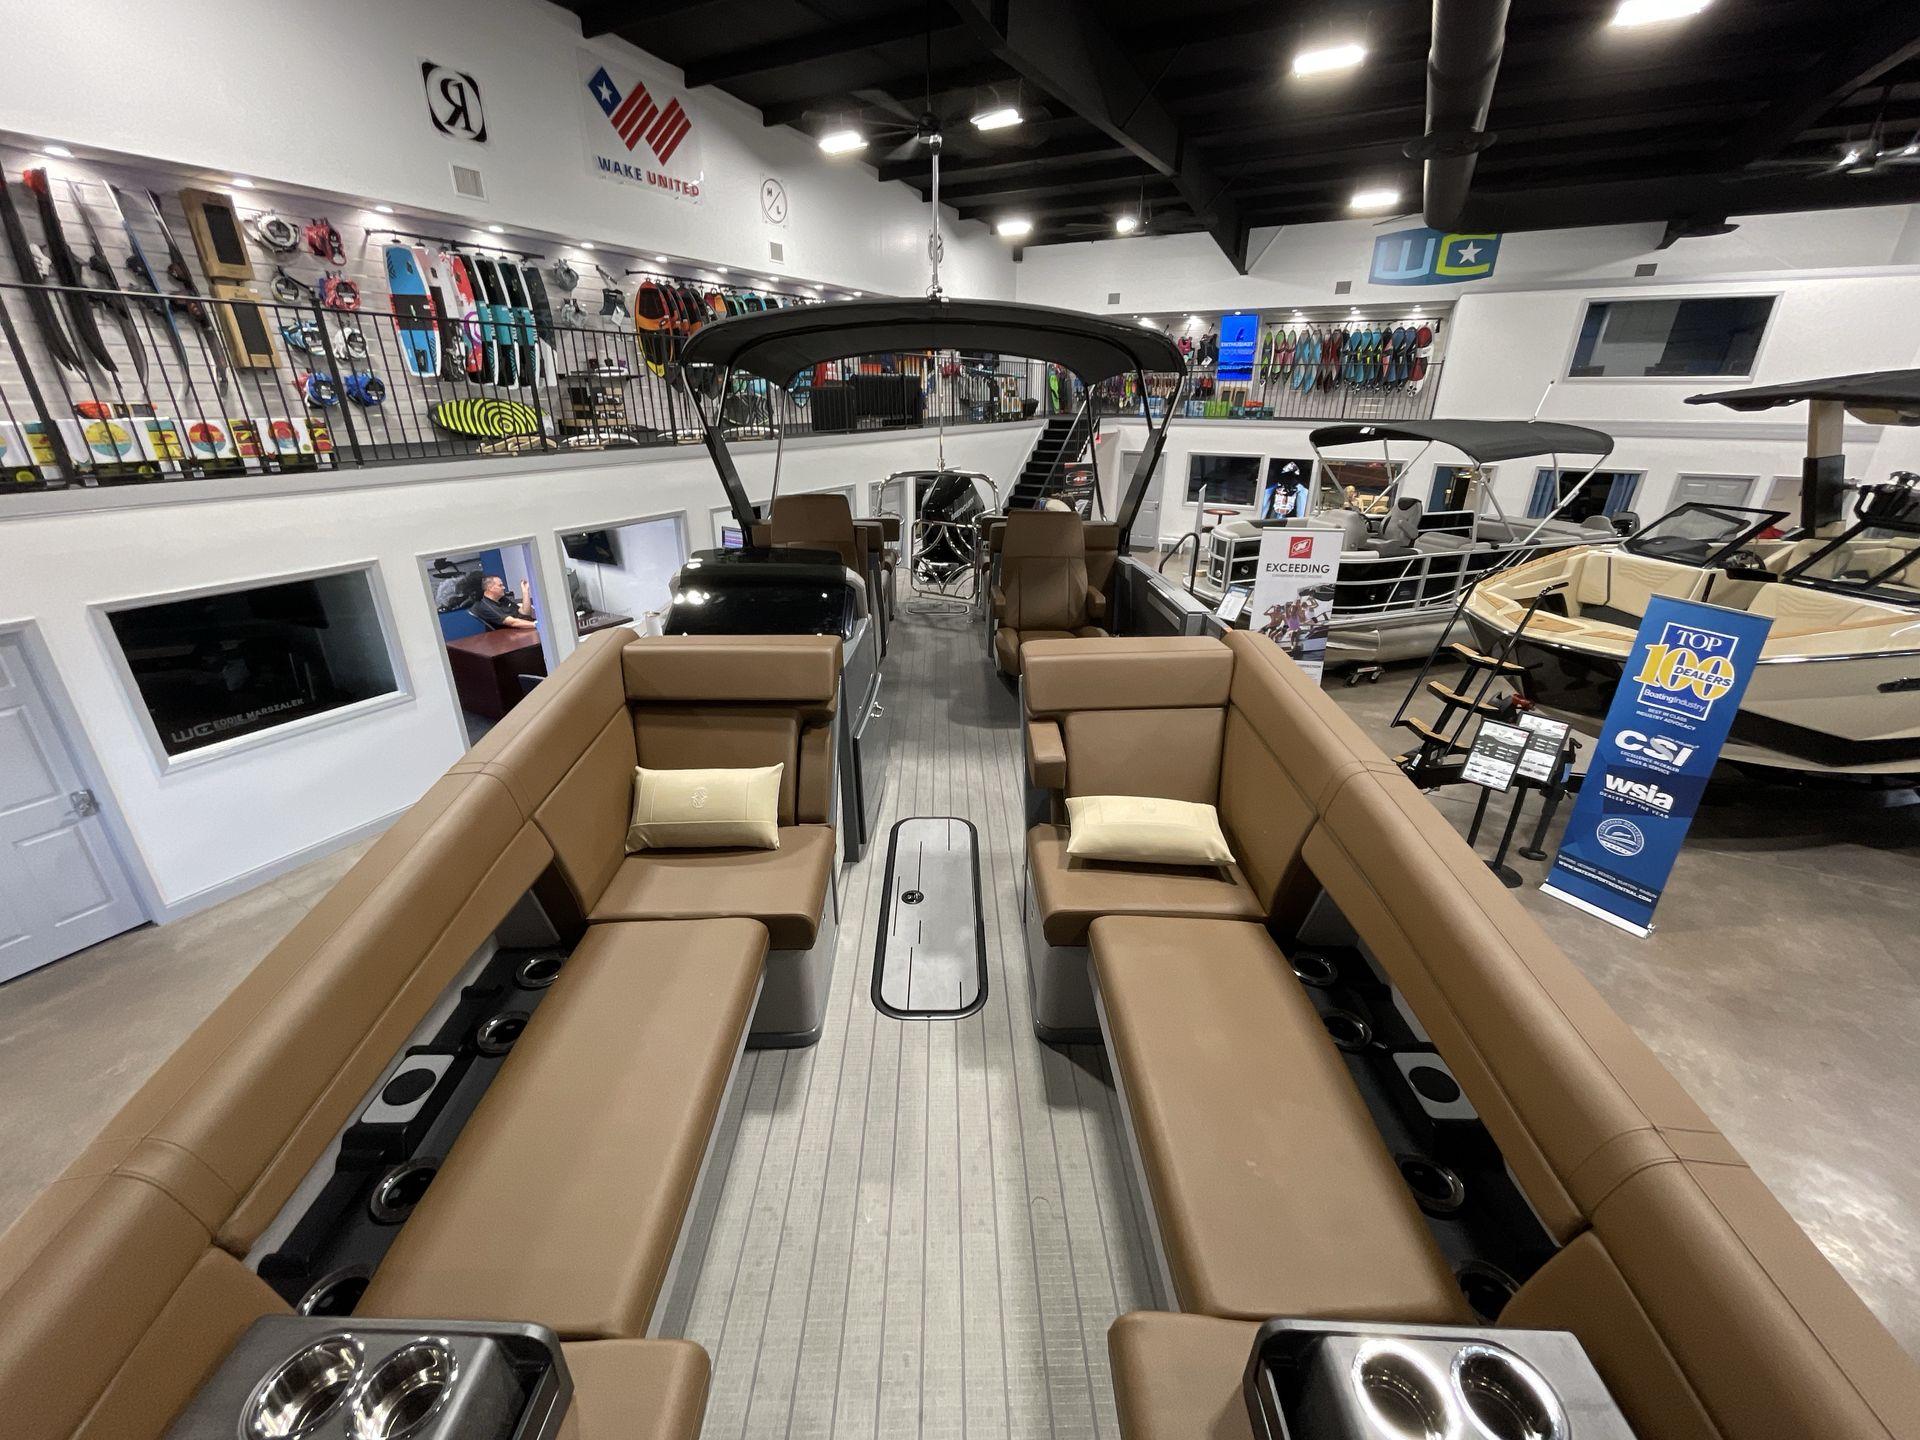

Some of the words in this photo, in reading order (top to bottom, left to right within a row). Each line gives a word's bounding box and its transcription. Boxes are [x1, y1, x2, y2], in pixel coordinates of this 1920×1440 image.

[596, 155, 643, 182] WAKE
[646, 170, 700, 198] UNITED
[1265, 562, 1331, 575] EXCEEDING
[1676, 629, 1723, 652] TOP
[1633, 643, 1735, 701] 100
[1673, 665, 1733, 687] DEALERS
[212, 713, 244, 731] EDDIE
[1614, 729, 1694, 767] CSI
[1599, 791, 1624, 803] DEALER
[1637, 803, 1650, 813] THE
[1651, 809, 1670, 819] YEAR
[1605, 773, 1674, 810] wsia
